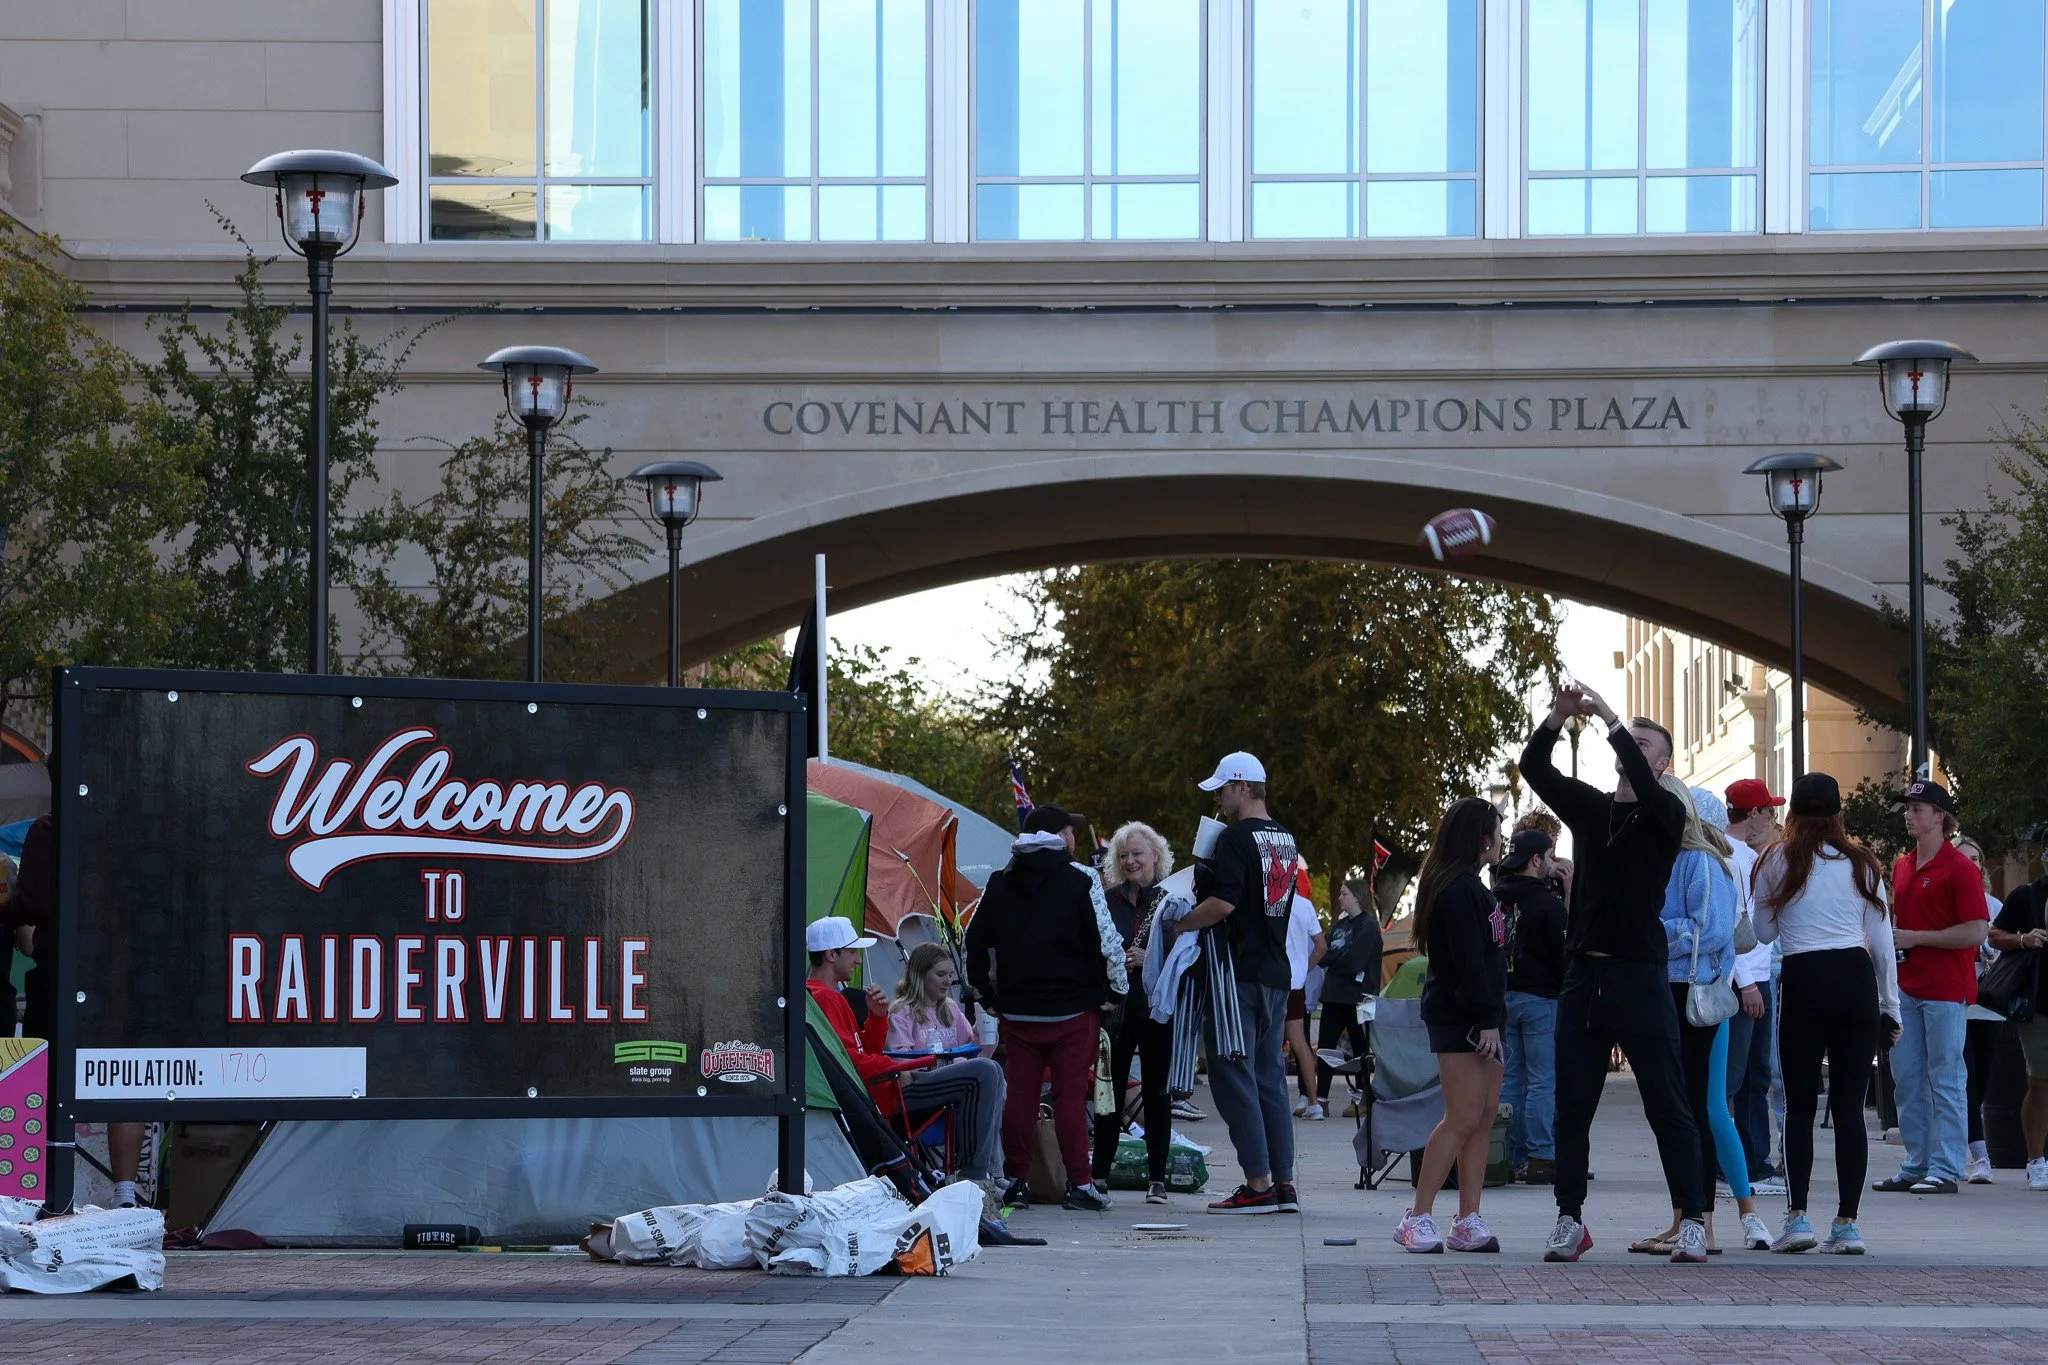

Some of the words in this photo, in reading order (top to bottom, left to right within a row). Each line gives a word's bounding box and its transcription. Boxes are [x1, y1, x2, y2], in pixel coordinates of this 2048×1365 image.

[763, 399, 1025, 435] COVENANT
[1041, 399, 1225, 434] HEALTH
[1238, 397, 1533, 434] CHAMPIONS
[1548, 396, 1691, 431] PLAZA
[245, 726, 636, 893] Welcome
[421, 869, 466, 923] TO
[228, 934, 650, 1023] RAIDERVILLE
[84, 1059, 203, 1087] POPULATION:
[220, 1052, 267, 1086] 1710
[629, 1066, 648, 1076] slate
[649, 1068, 672, 1077] group
[701, 1049, 775, 1081] OUTFITTER
[440, 1231, 455, 1243] HSC
